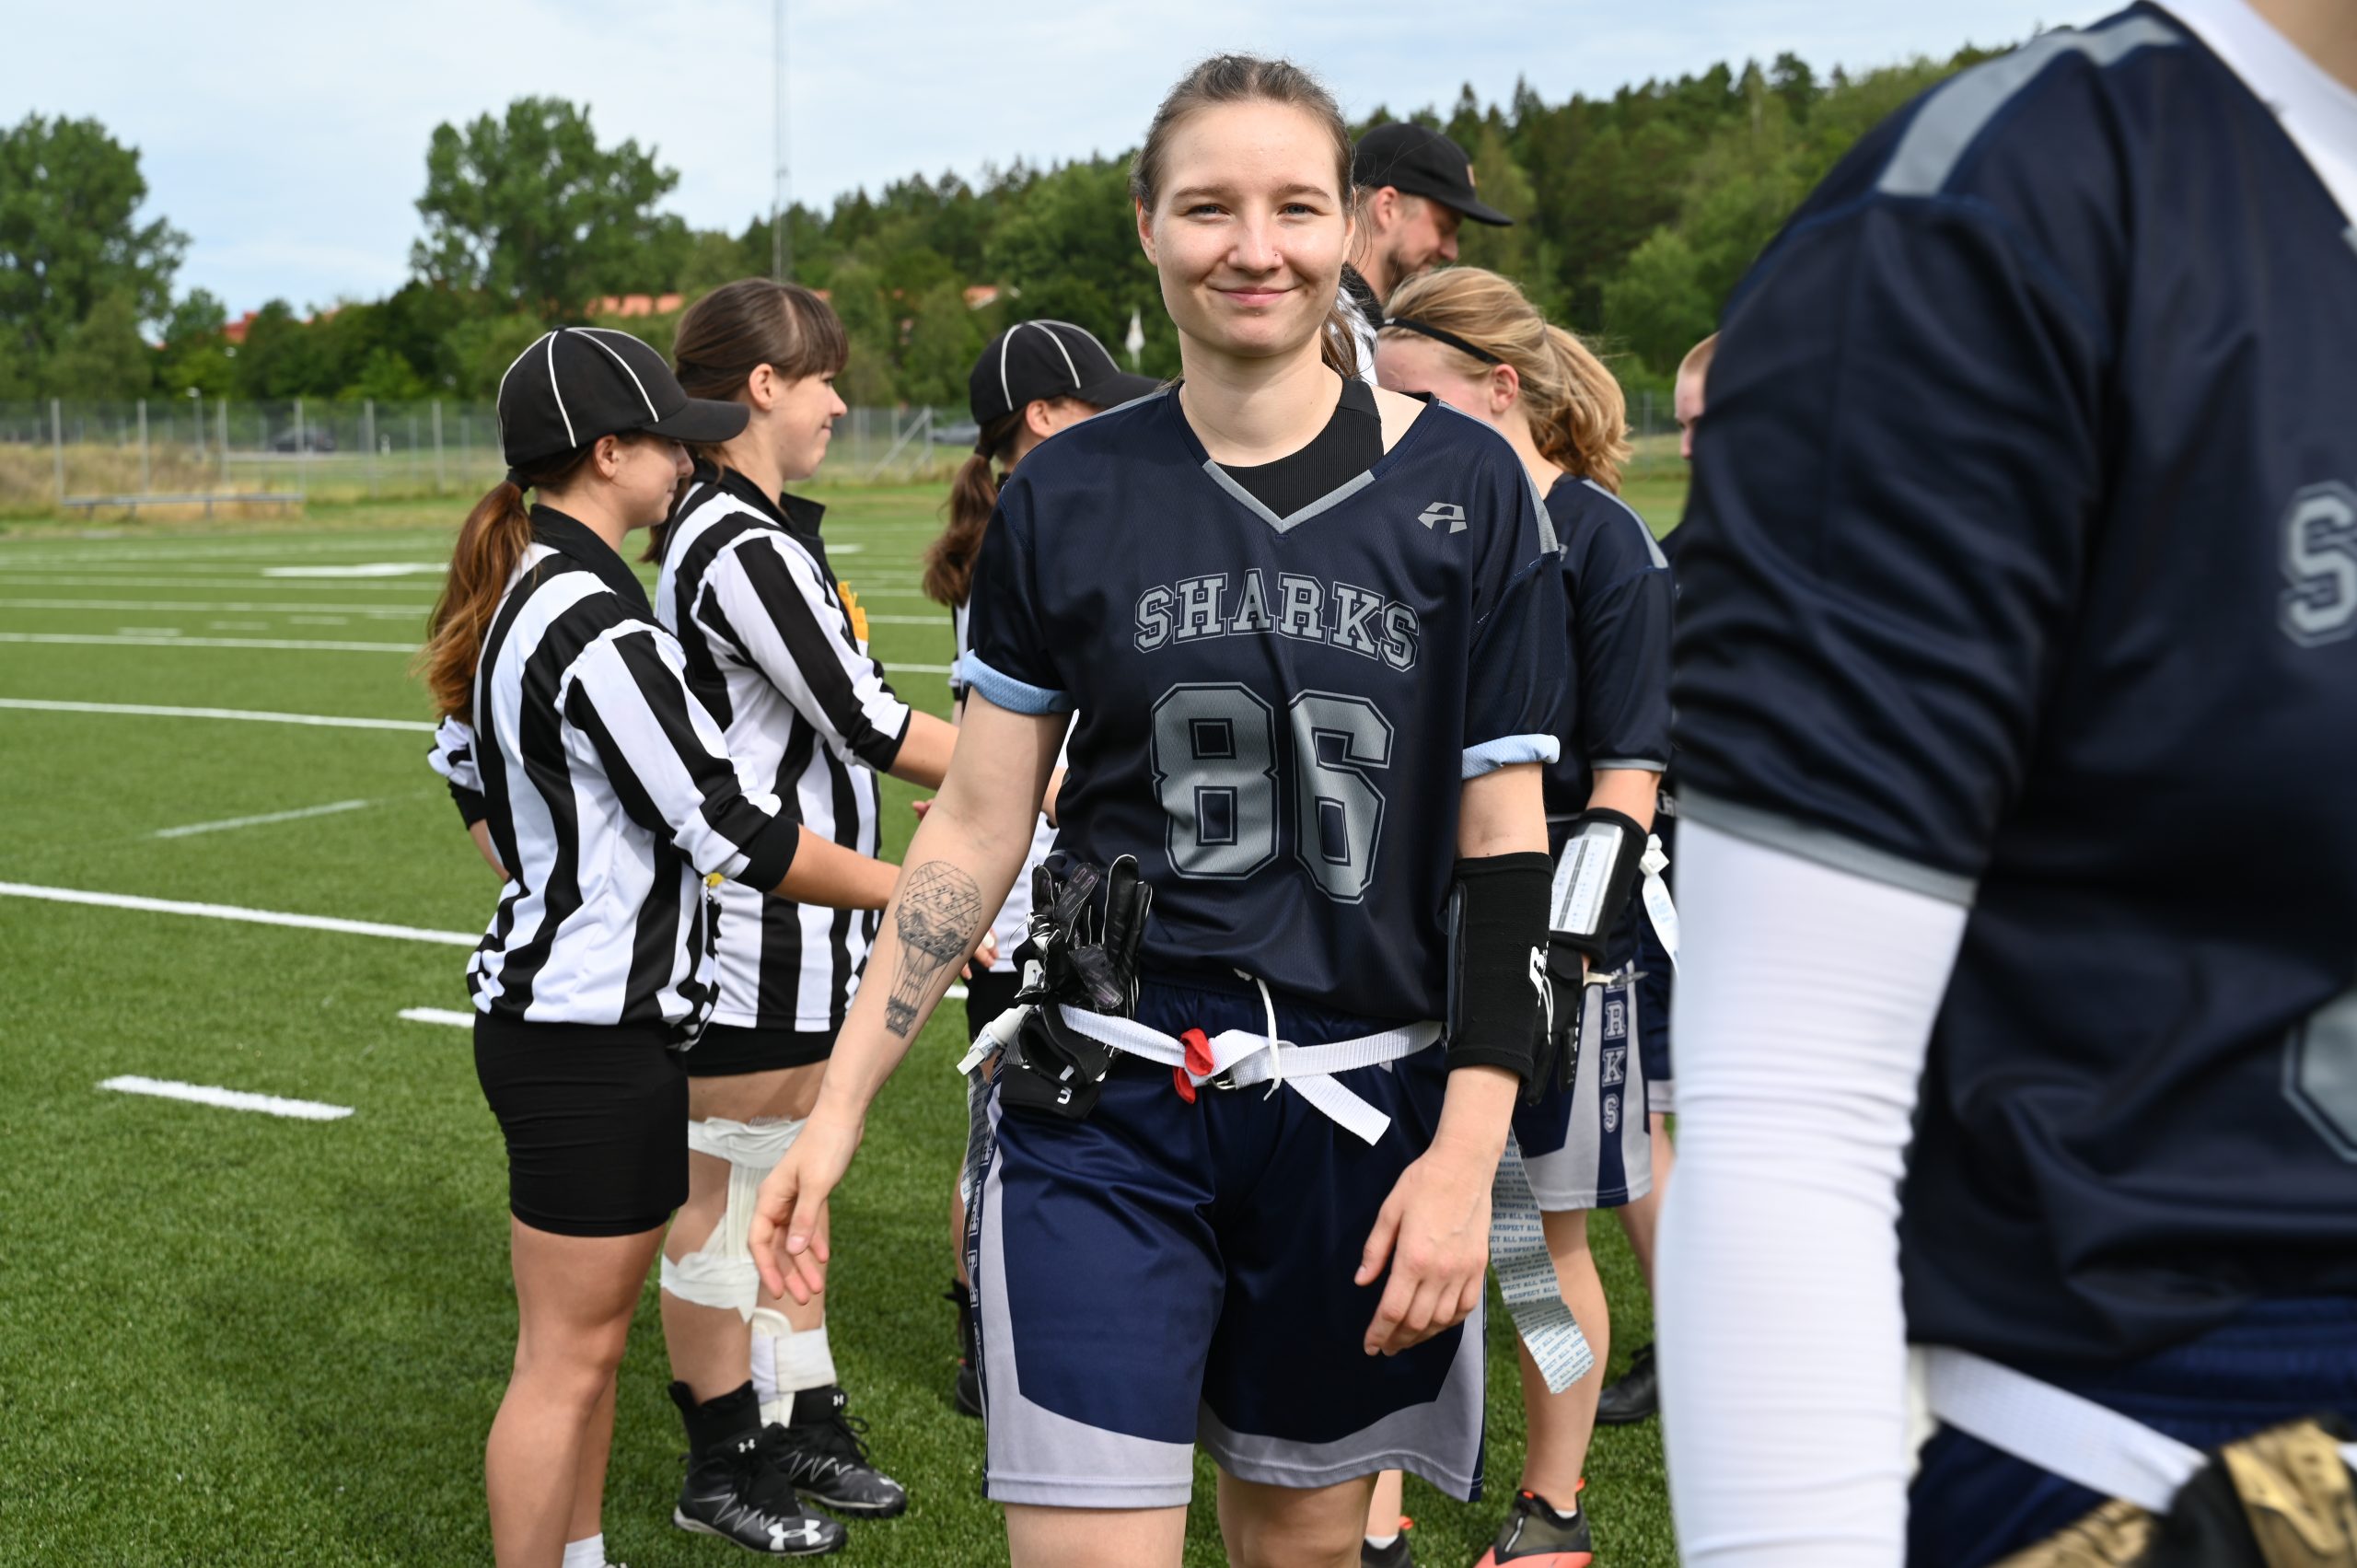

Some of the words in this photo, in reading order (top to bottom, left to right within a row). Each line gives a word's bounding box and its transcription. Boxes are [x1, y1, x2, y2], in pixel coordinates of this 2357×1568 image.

[1134, 568, 1419, 672] SHARKS
[1150, 681, 1395, 905] 86
[1493, 1224, 1525, 1232] RESPECT
